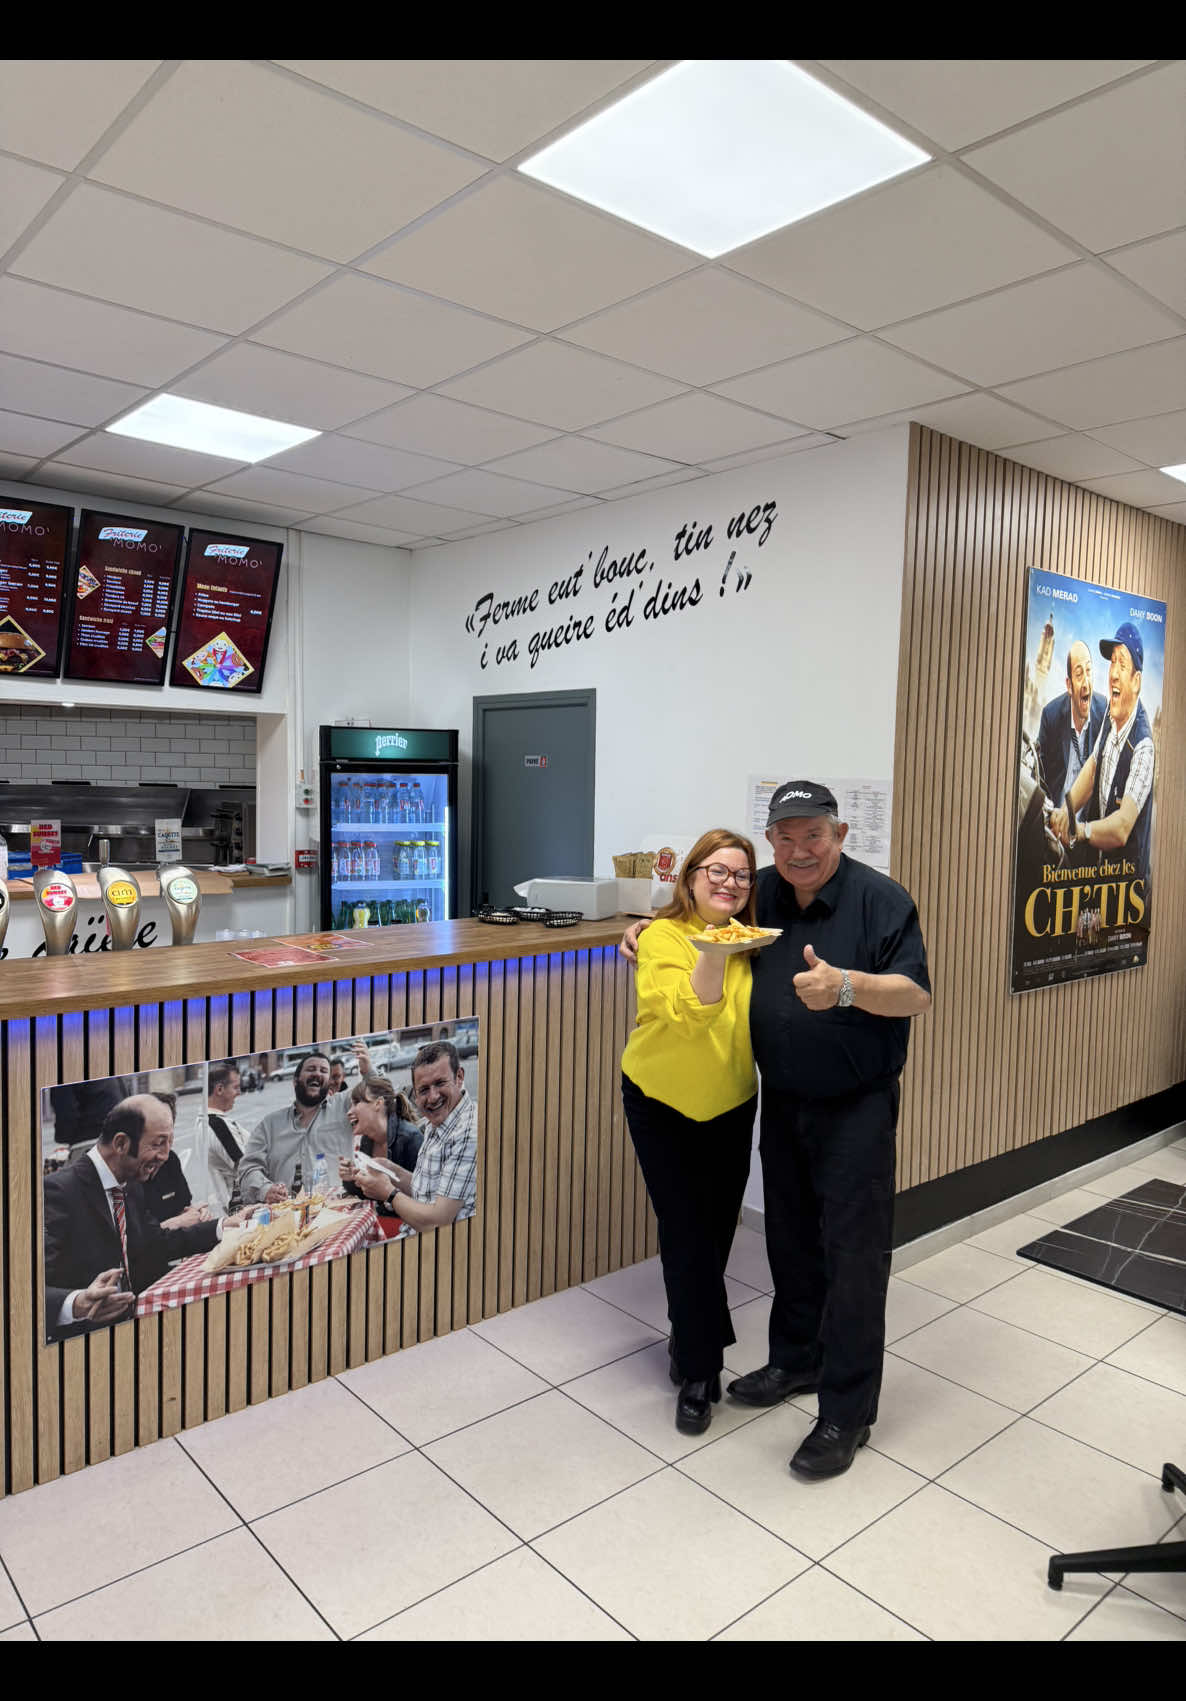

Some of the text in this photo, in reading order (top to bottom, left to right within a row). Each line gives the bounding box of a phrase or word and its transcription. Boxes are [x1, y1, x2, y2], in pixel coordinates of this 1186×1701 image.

[674, 521, 714, 562] tin
[727, 500, 777, 547] nez
[1036, 584, 1051, 597] KAD
[1052, 588, 1078, 603] MERAD
[1130, 608, 1162, 623] DANY BOON
[480, 643, 489, 670] i
[495, 640, 520, 665] va
[527, 615, 595, 669] queire
[1043, 859, 1135, 883] Bienvenue chez les
[1024, 879, 1145, 937] CH'TIS
